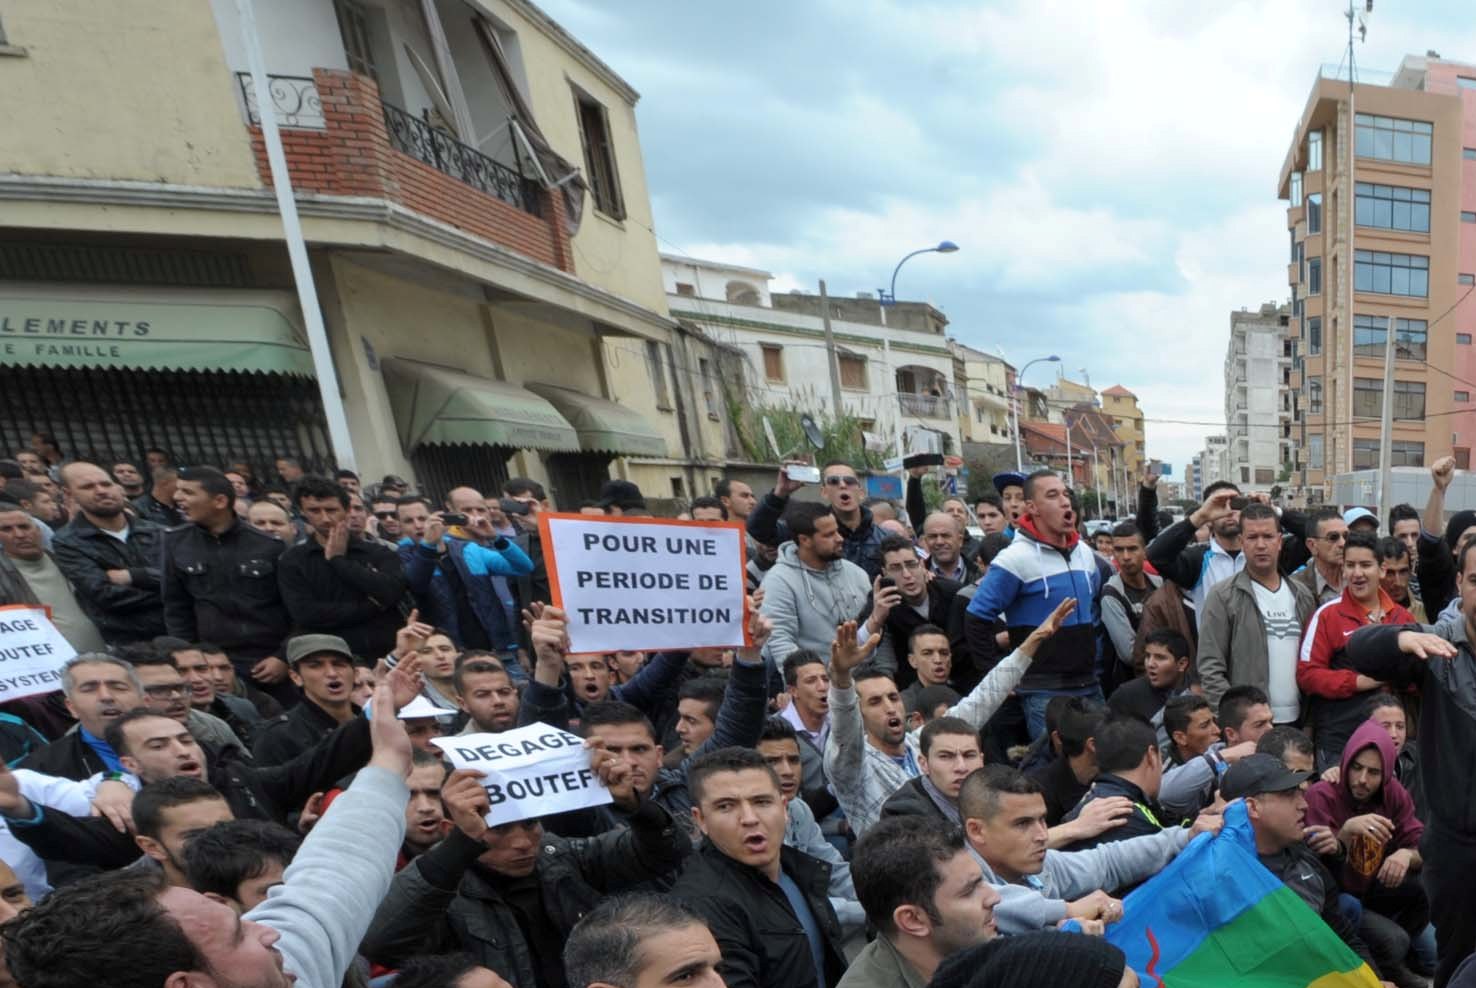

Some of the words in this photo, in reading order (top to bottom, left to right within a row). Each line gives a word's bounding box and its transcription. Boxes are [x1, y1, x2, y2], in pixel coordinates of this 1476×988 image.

[1, 316, 151, 336] LEMENTS
[35, 344, 120, 357] FAMILLE
[583, 533, 657, 553] POUR
[666, 538, 717, 556] UNE
[577, 571, 690, 590] PERIODE
[698, 575, 728, 590] DE
[577, 608, 730, 624] TRANSITION
[455, 731, 581, 762] DEGAGE
[484, 768, 593, 806] BOUTEF
